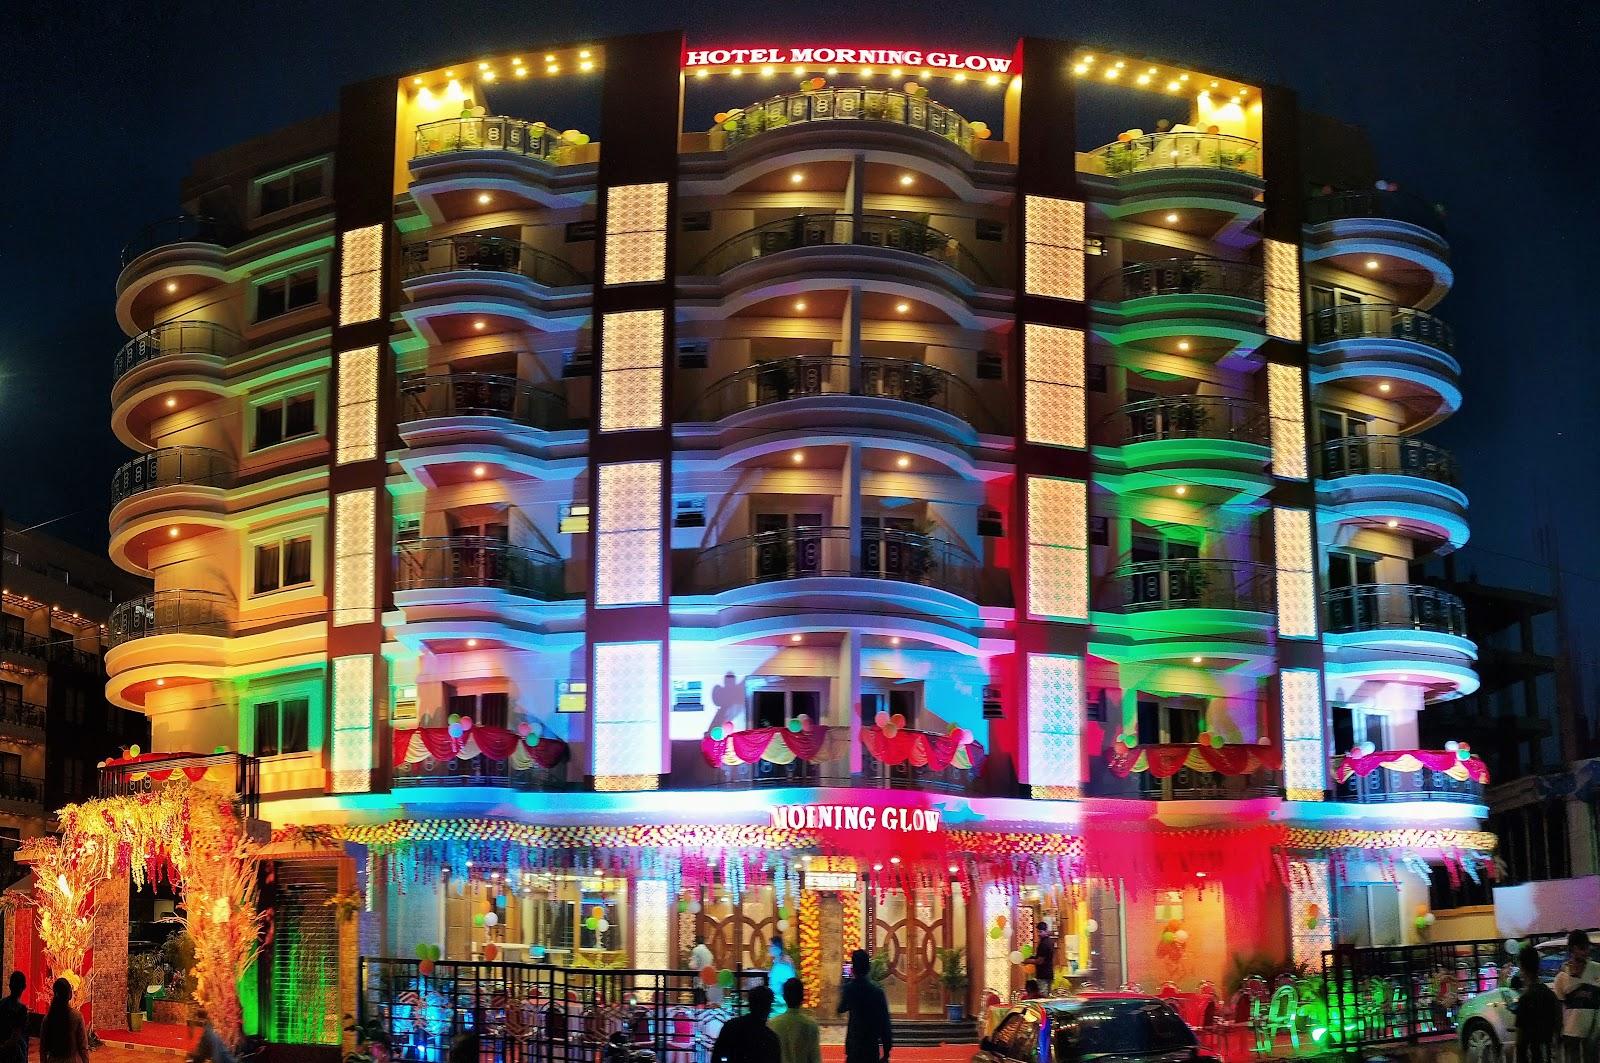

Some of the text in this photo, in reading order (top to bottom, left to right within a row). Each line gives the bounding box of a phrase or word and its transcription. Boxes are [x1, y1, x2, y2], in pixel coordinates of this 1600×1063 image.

[686, 48, 1012, 73] HOTEL MORNING GLOW
[881, 807, 940, 833] GLOW
